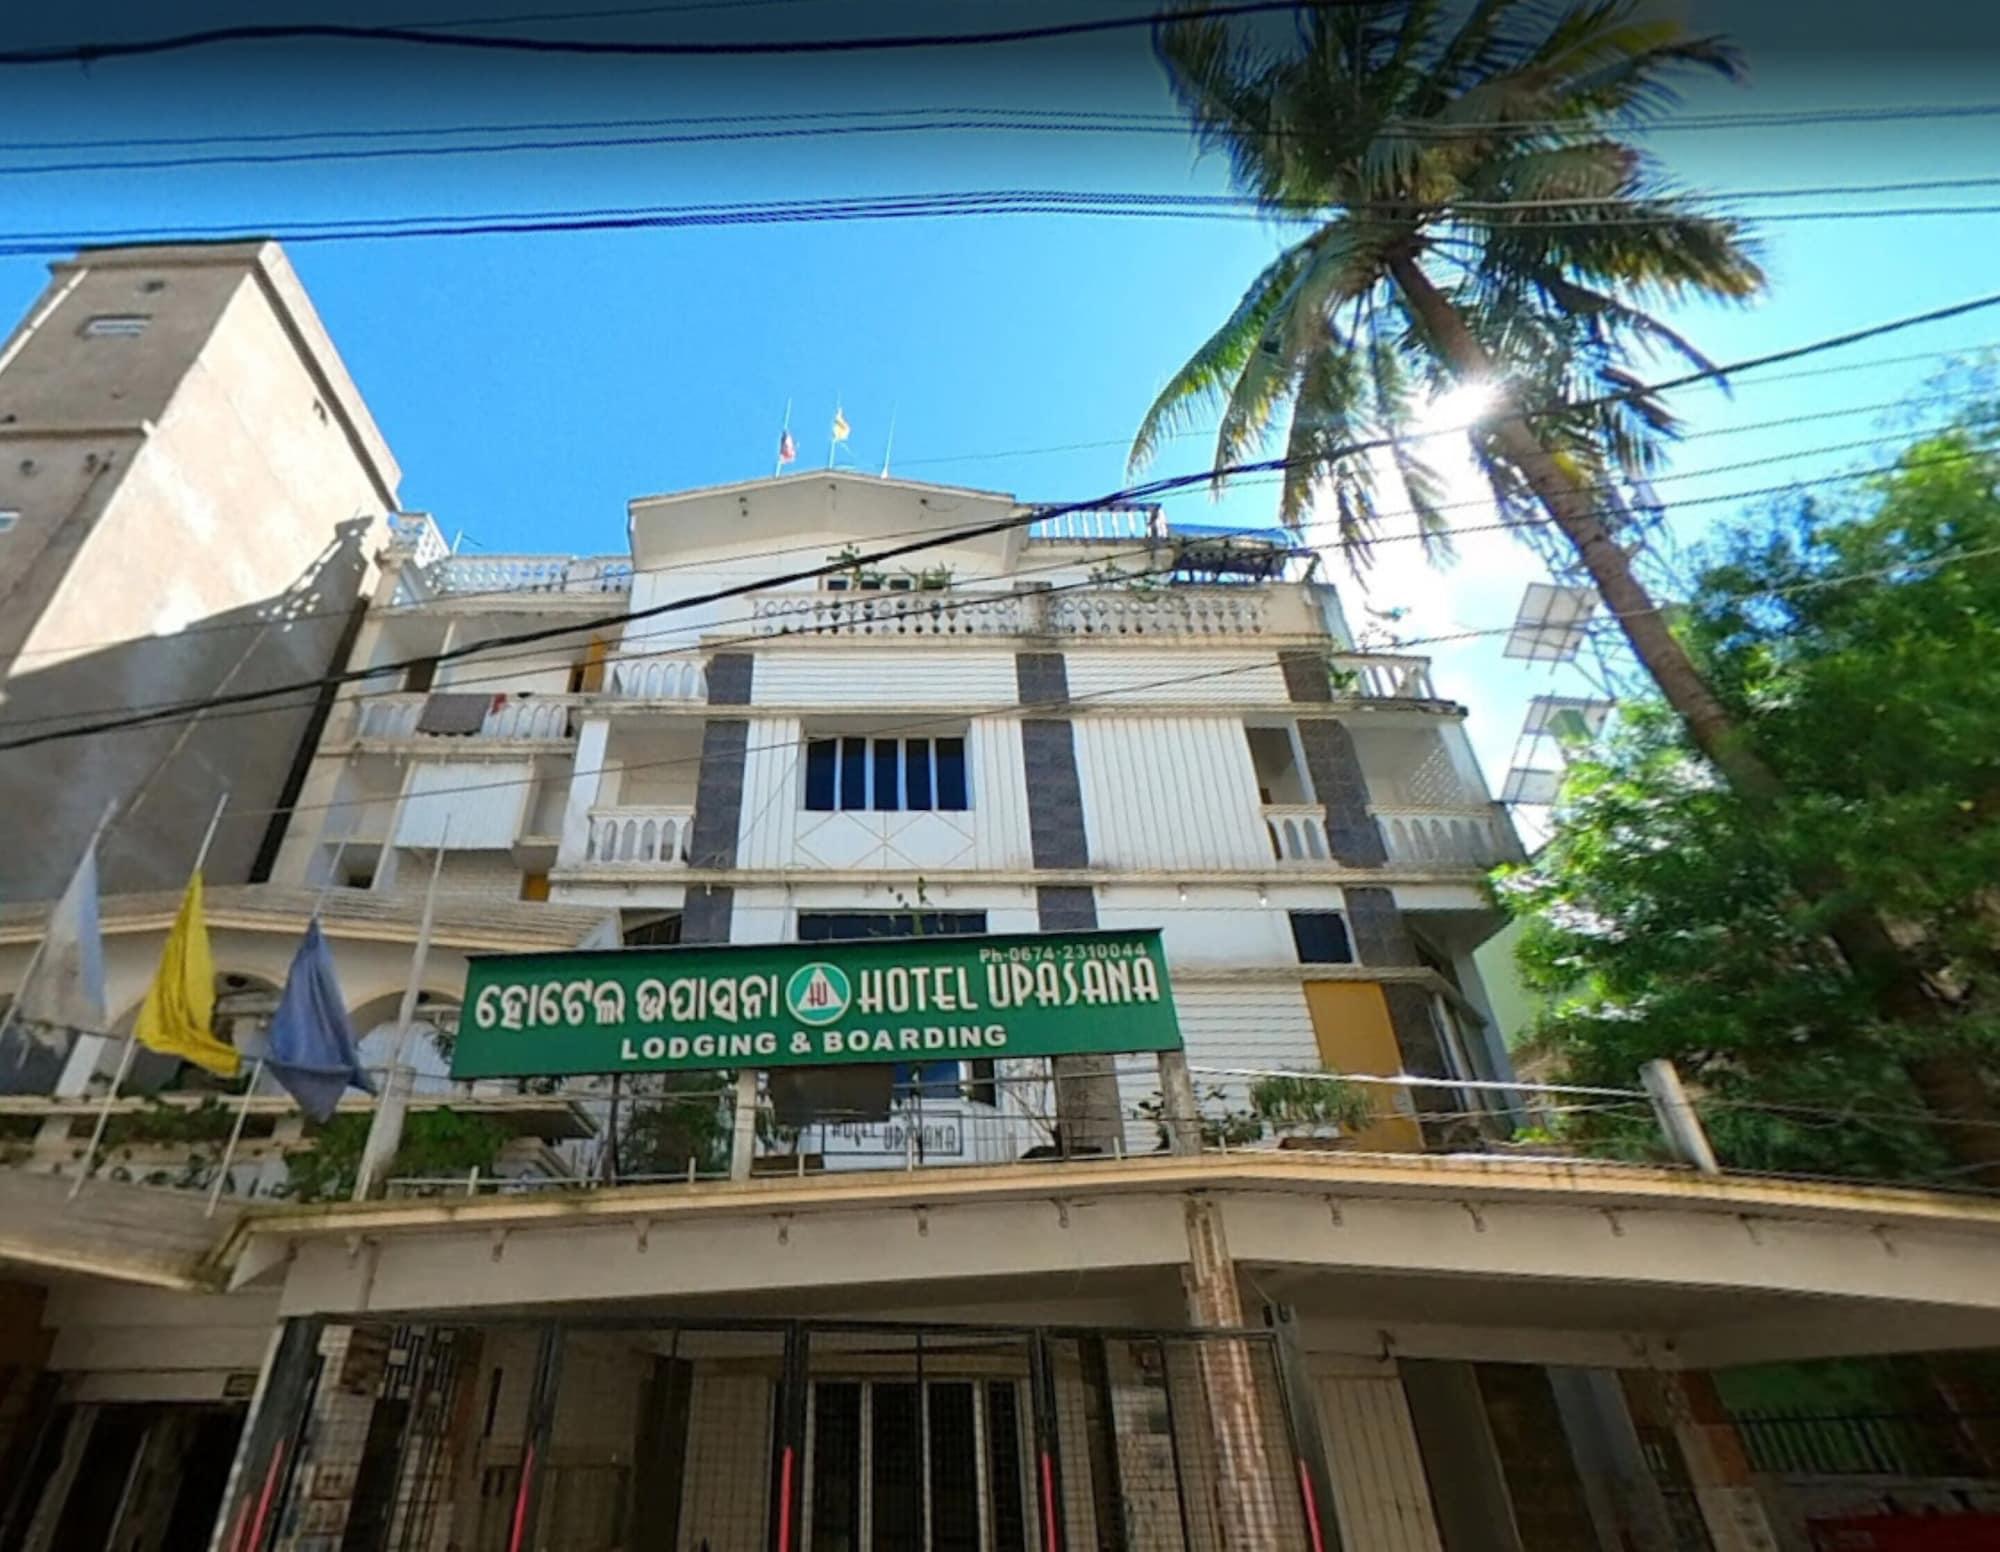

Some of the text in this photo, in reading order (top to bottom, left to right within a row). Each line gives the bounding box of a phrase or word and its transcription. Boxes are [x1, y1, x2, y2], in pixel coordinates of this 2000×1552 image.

[475, 974, 778, 1030] ହୋଟେଲ ଉପାସନା
[858, 957, 1160, 1014] HOTEL UPASANA
[621, 1025, 1007, 1060] LODGING & BOARDING
